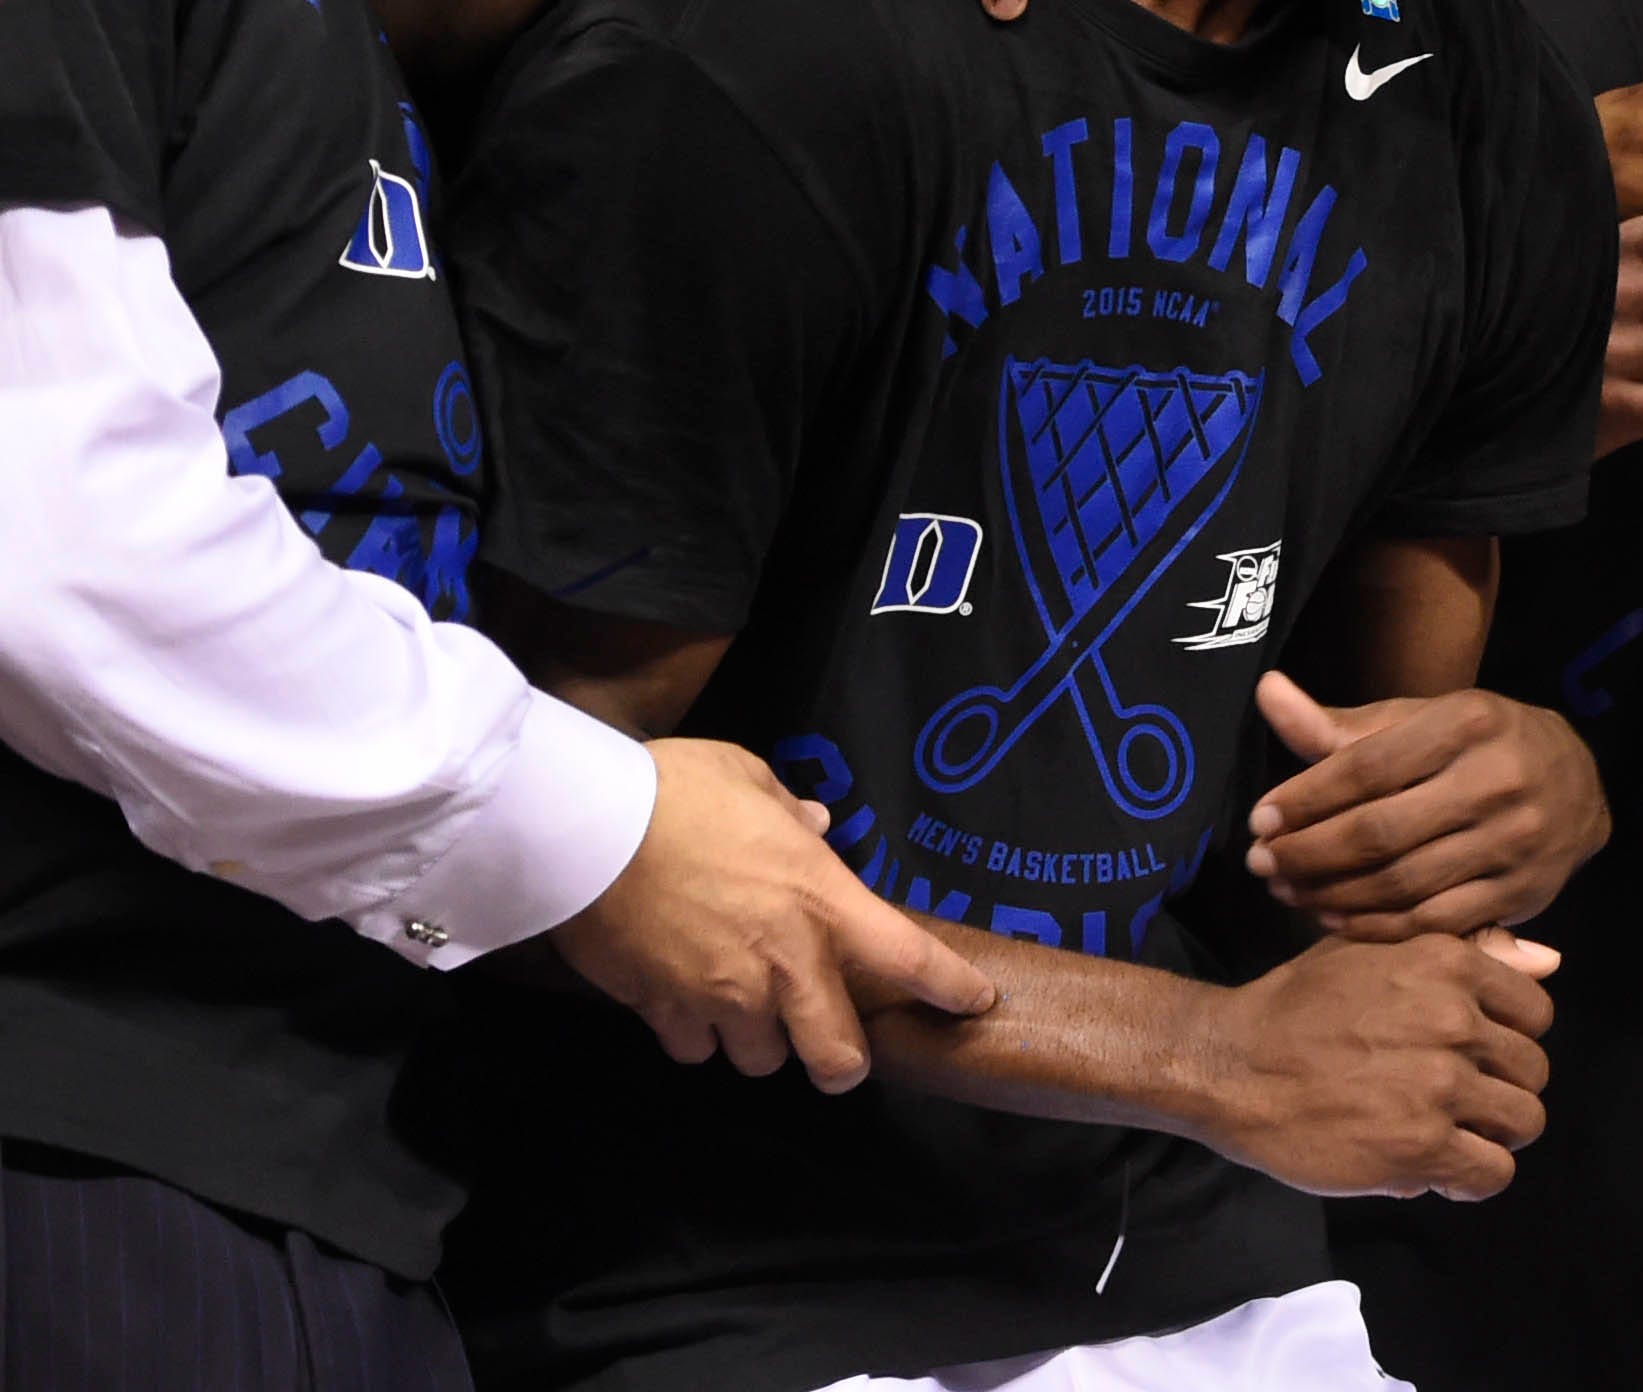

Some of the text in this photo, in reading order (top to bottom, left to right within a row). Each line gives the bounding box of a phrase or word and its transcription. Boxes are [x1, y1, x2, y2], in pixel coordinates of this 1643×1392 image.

[926, 116, 1368, 388] NATIONAL
[1082, 286, 1144, 319] 2015
[905, 812, 1166, 885] MEN'S BASKETBALL
